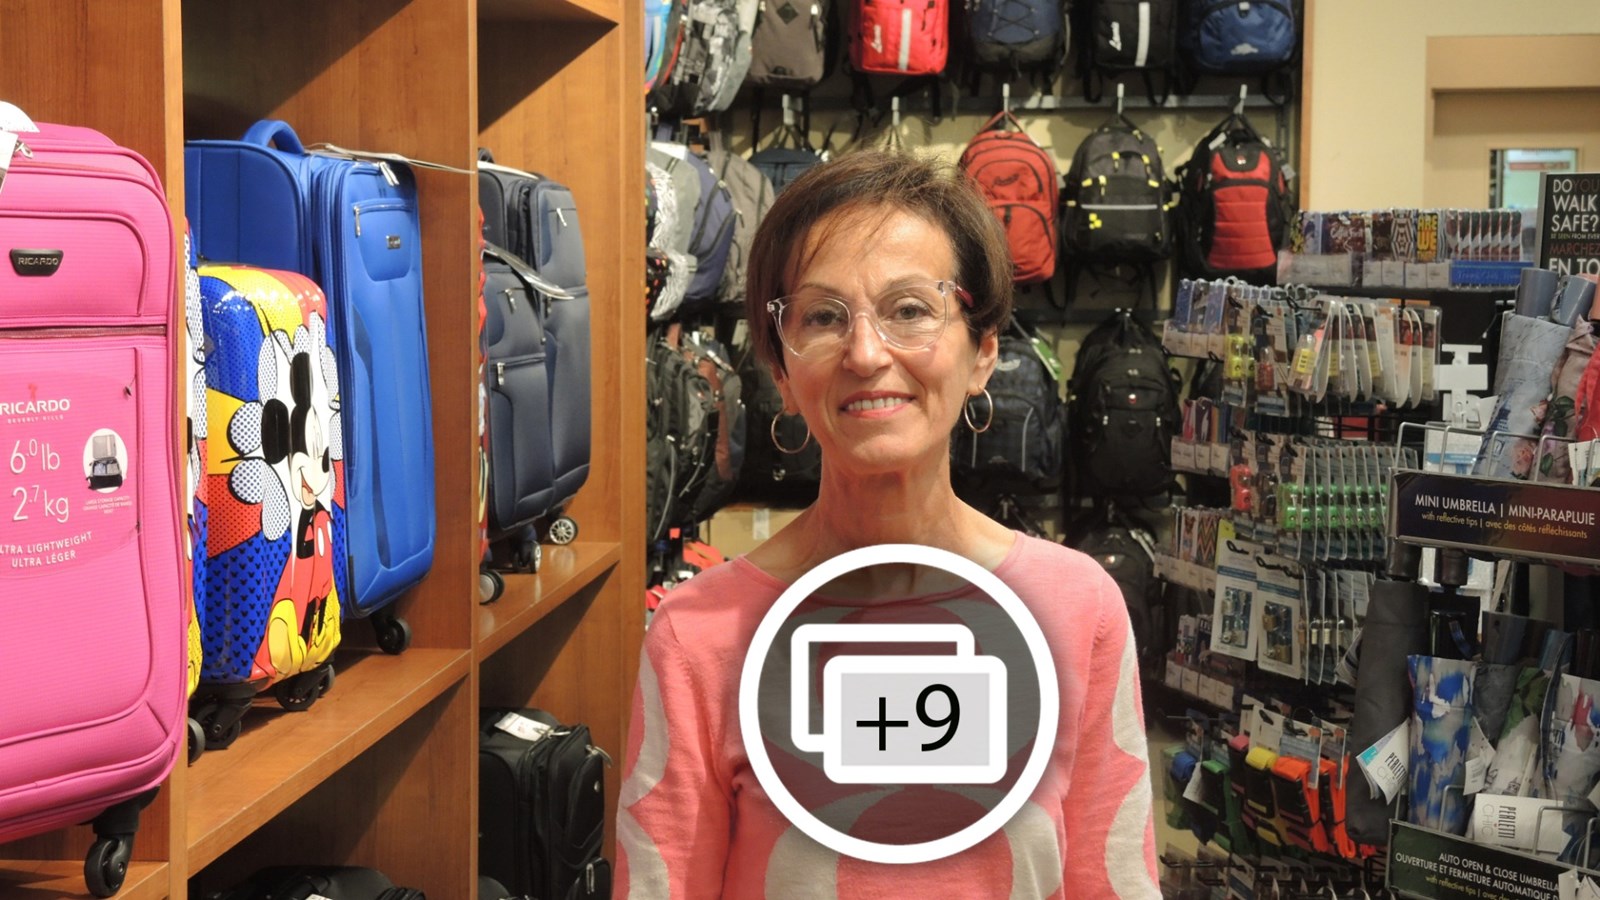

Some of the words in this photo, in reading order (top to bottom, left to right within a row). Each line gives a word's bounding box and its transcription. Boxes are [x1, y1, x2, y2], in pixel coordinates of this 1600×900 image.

[1553, 178, 1573, 193] DO
[1552, 194, 1598, 212] WALK
[1551, 214, 1600, 232] SAFE?
[1549, 242, 1600, 256] MARCHEZ
[18, 257, 59, 266] RICARDO
[0, 398, 71, 416] RICARDO
[41, 442, 61, 472] lb
[43, 488, 70, 524] kg
[1415, 494, 1440, 508] MINI
[1442, 496, 1497, 516] UMBRELLA
[1508, 504, 1596, 526] MINI-PARAPLUIE
[1421, 511, 1435, 521] with
[1436, 511, 1465, 525] reflective
[1466, 516, 1478, 529] tips
[1485, 520, 1503, 530] avec
[1503, 520, 1516, 532] des
[1518, 522, 1537, 534] côtés
[1538, 522, 1588, 540] réfléchissants
[27, 531, 93, 554] LIGHTWEIGHT
[12, 556, 43, 569] ULTRA
[46, 549, 76, 565] LÉGER
[1395, 852, 1438, 872] OUVERTURE
[1439, 864, 1448, 875] ET
[1449, 866, 1491, 887] FERMETURE
[1492, 879, 1551, 900] AUTOMATIQUE
[1439, 852, 1460, 866] AUTO
[1461, 858, 1484, 872] OPEN
[1485, 864, 1492, 875] &
[1493, 867, 1518, 882] CLOSE
[1520, 873, 1559, 892] UMBRELLA
